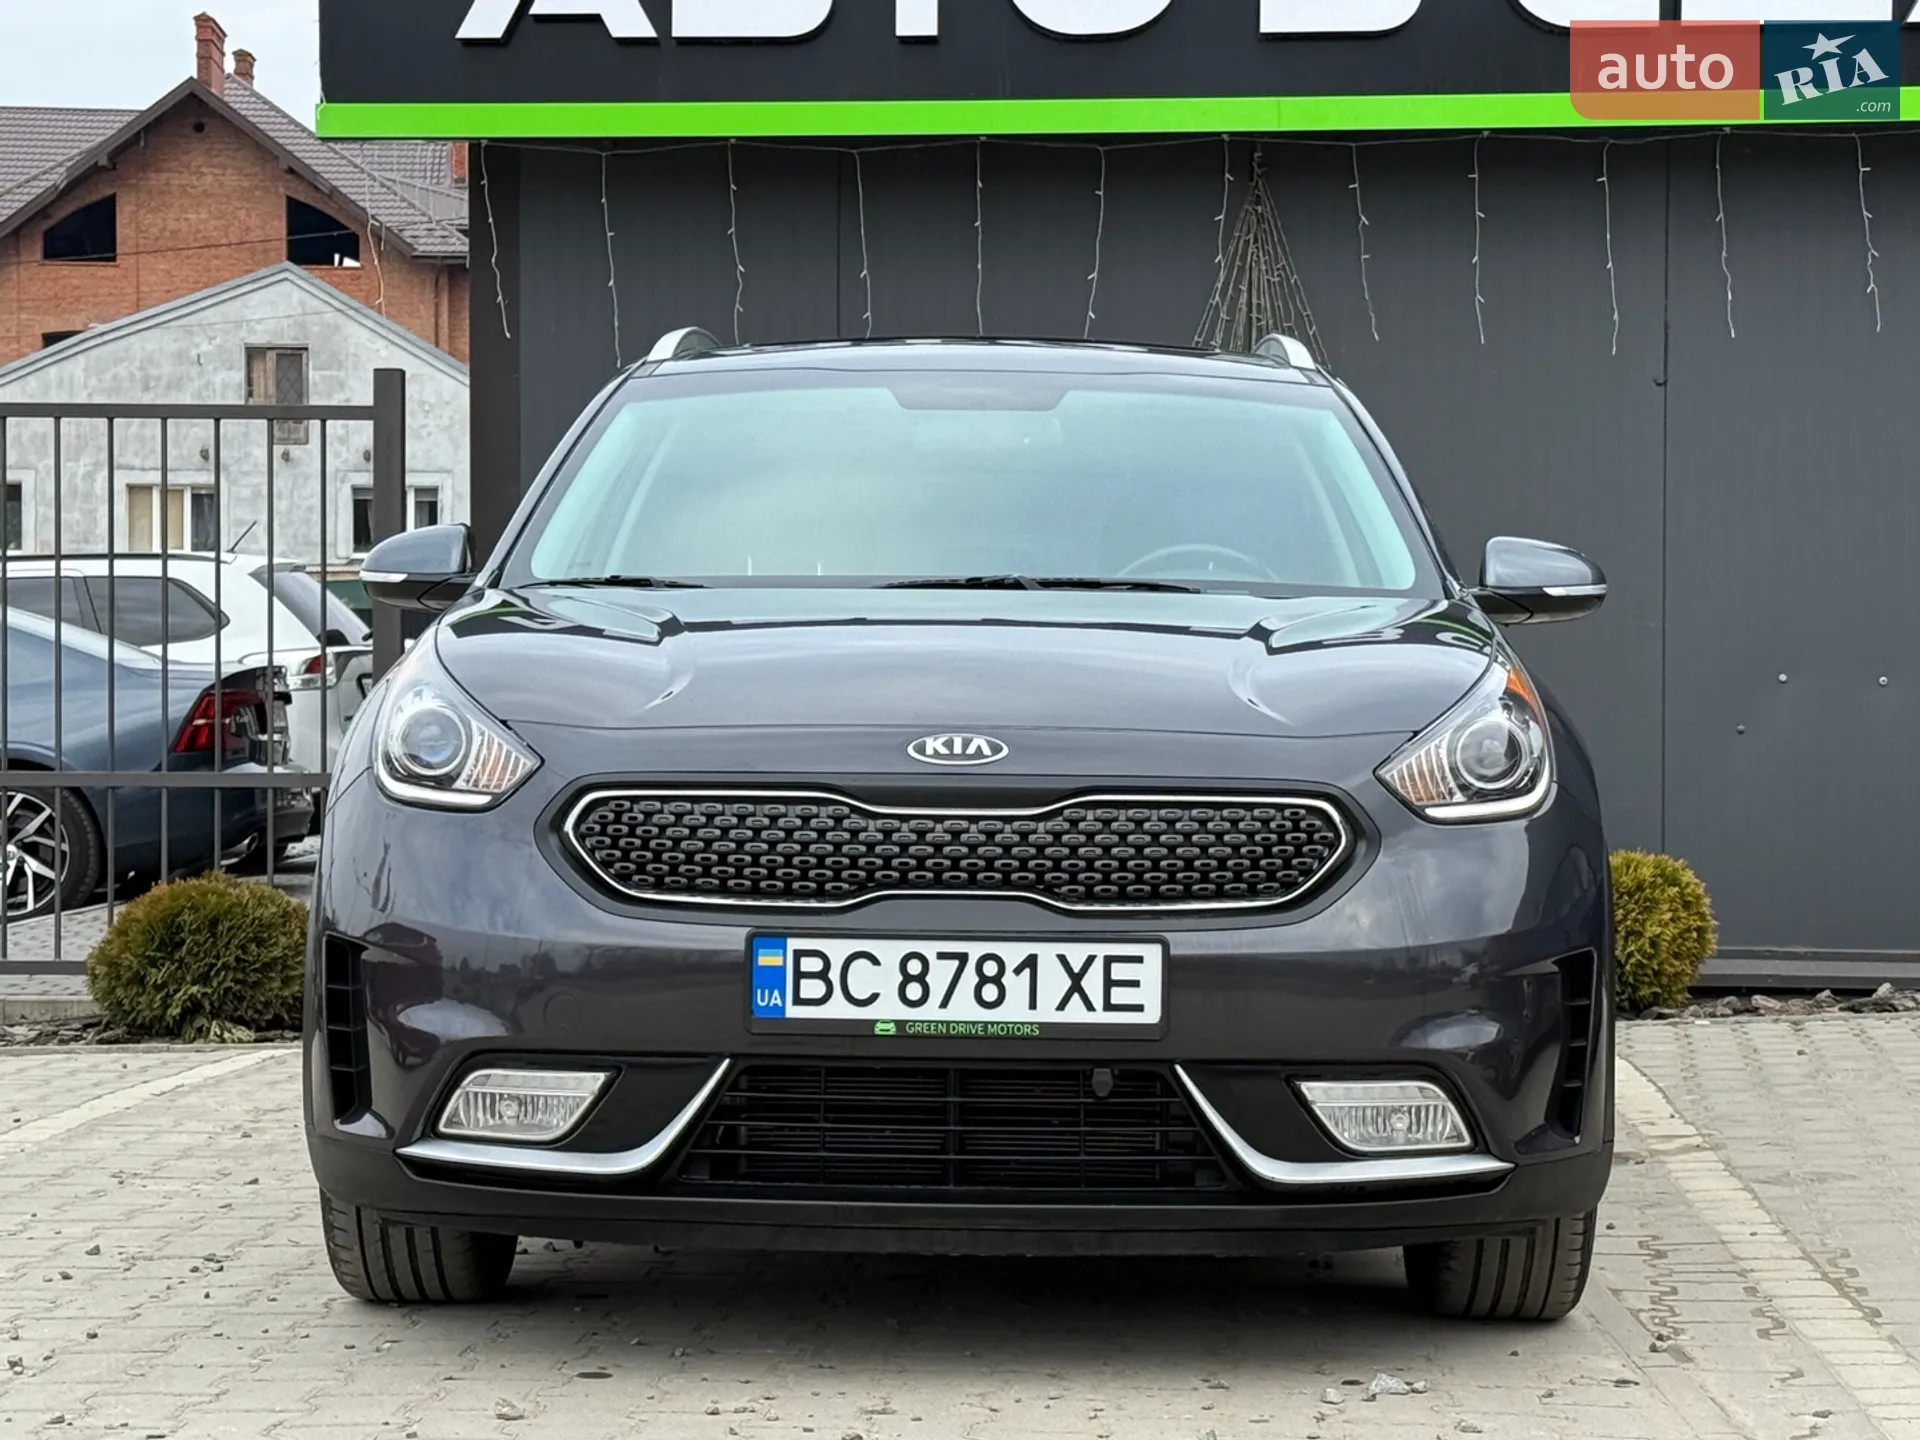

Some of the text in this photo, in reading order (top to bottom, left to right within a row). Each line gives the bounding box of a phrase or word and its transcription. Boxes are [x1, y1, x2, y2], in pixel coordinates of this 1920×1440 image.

[923, 736, 993, 757] KIA
[791, 948, 1145, 1013] BC 8781 XE
[756, 988, 783, 1007] UA
[905, 1021, 1040, 1036] GREEN DRIVE MOTORS
